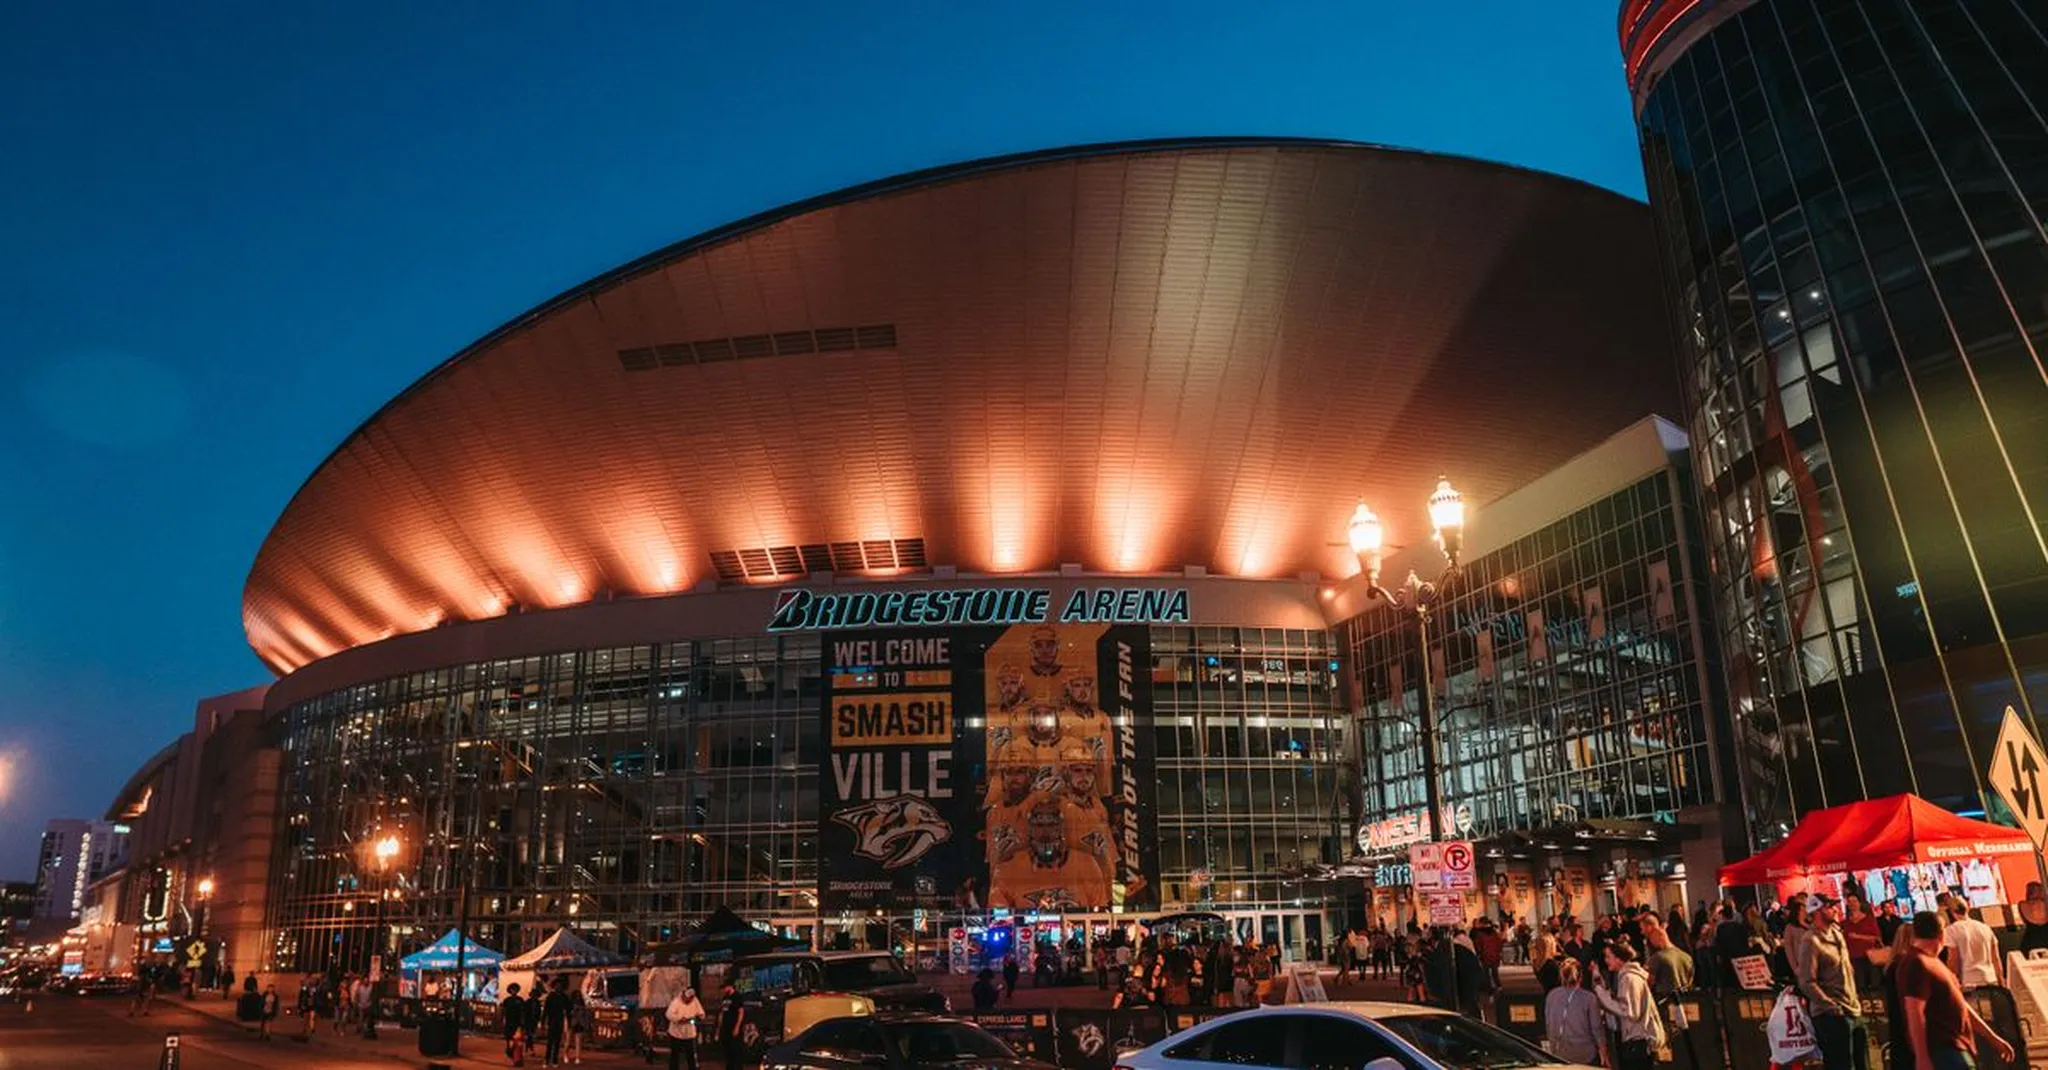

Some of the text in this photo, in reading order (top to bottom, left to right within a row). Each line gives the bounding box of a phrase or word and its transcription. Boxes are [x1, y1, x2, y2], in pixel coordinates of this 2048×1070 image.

[767, 588, 1191, 632] BRIDGESTONE ARENA
[834, 638, 950, 666] WELCOME
[884, 672, 899, 687] TO
[838, 701, 945, 738] SMASH
[831, 751, 953, 800] VILLE
[1117, 642, 1140, 884] YEAR OF THE FAN
[1375, 864, 1412, 888] ENTR
